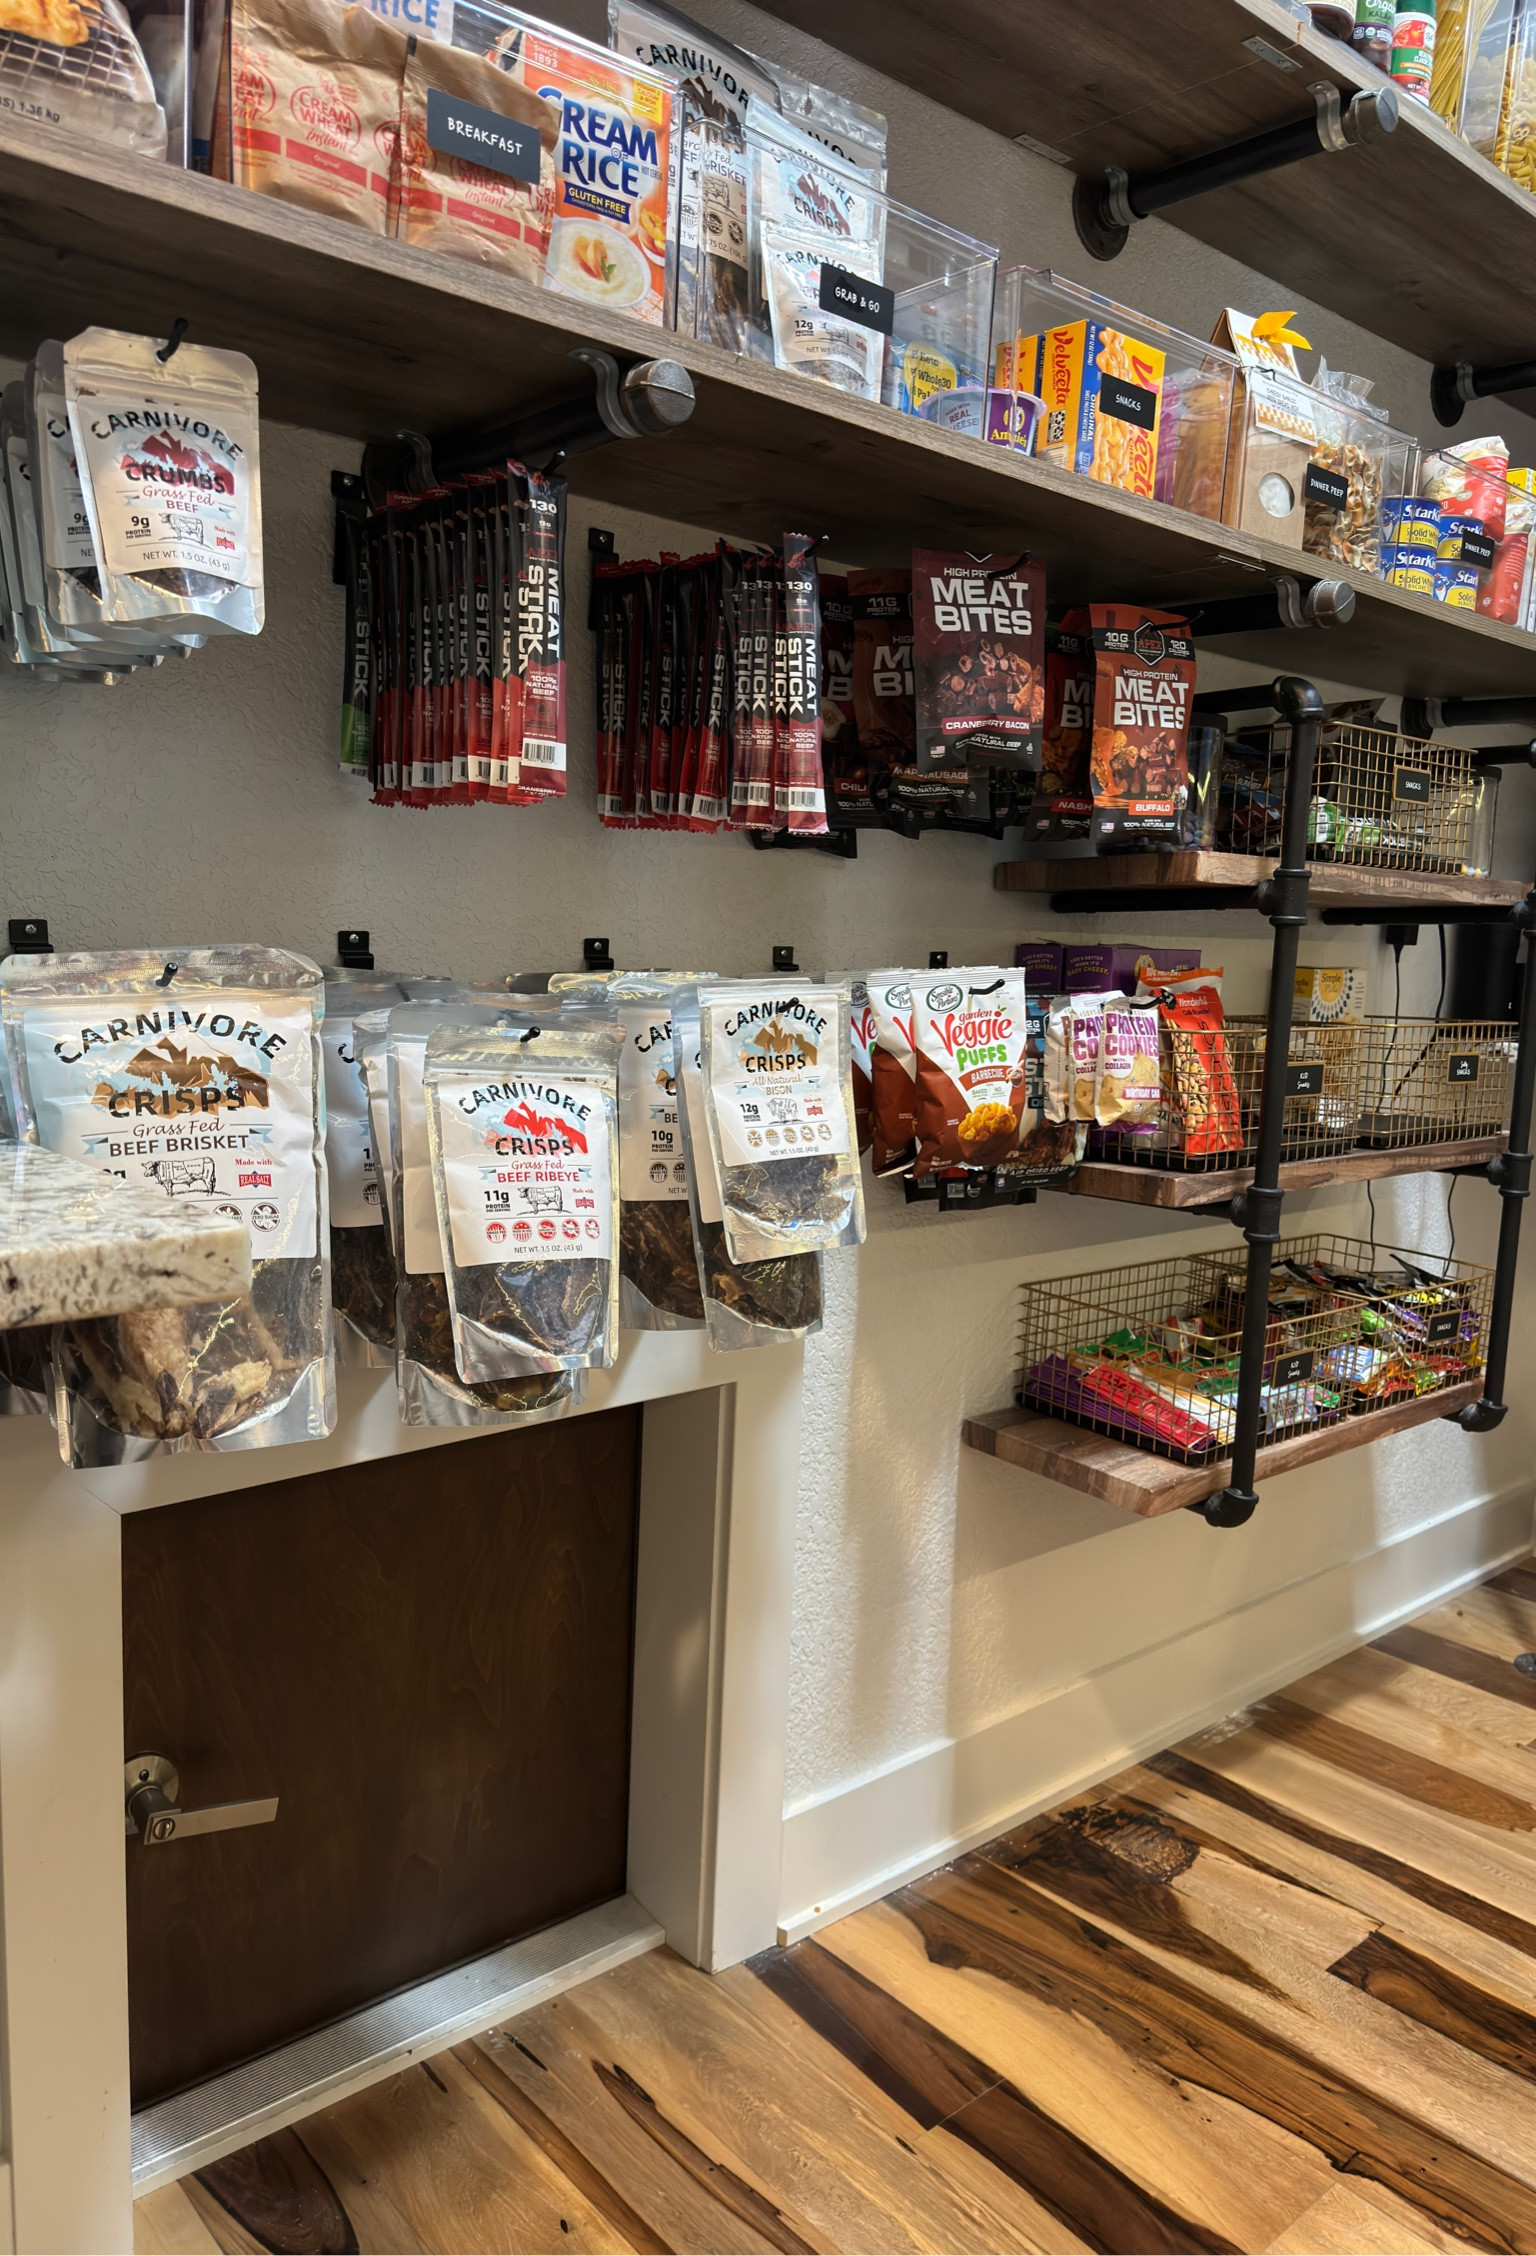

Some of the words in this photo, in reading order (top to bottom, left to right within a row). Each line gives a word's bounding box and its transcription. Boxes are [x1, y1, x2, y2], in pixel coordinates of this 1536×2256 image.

[533, 52, 558, 68] 1893
[299, 90, 353, 126] CREAM
[299, 107, 351, 141] WHEAT
[447, 117, 523, 156] BREAKFAST
[611, 148, 628, 161] OF
[562, 139, 640, 199] RICE
[710, 161, 747, 185] RISKET
[568, 187, 603, 206] GLUTEN
[604, 200, 626, 215] FREE
[794, 196, 843, 236] CRISPS
[834, 286, 857, 305] GRAB
[860, 296, 867, 308] &
[868, 300, 880, 313] GO
[794, 319, 813, 331] 12g
[919, 351, 940, 367] Keto
[1053, 330, 1074, 405] Velveeta
[918, 369, 951, 391] Whole30
[1115, 394, 1142, 412] SNACKS
[949, 409, 971, 424] REAL
[1088, 394, 1096, 442] ORIGINAL
[91, 411, 243, 461] CARNIVORE
[125, 463, 225, 495] CRUMBS
[1310, 478, 1329, 492] DINNER
[1330, 484, 1344, 498] PREP
[143, 485, 185, 499] Grass
[188, 490, 215, 506] Fed
[166, 500, 198, 513] BEEF
[530, 499, 557, 514] 130
[131, 515, 150, 528] 9g
[125, 528, 151, 537] PROTEIN
[143, 551, 160, 560] NET
[181, 551, 192, 560] 1.5
[1464, 542, 1479, 553] DINNER
[1480, 547, 1491, 557] PREP
[943, 567, 969, 577] HIGH
[786, 581, 812, 591] 130
[930, 577, 1029, 608] MEAT
[528, 564, 544, 656] STICK
[547, 568, 561, 658] MEAT
[934, 605, 1032, 635] BITES
[476, 593, 491, 677] STICK
[1104, 641, 1129, 649] PROTEIN
[1105, 632, 1129, 643] 10G
[1170, 640, 1187, 650] 120
[354, 621, 370, 697] STICK
[530, 675, 556, 685] 100%
[736, 637, 751, 712] STICK
[752, 636, 768, 711] STICK
[775, 638, 787, 715] STICK
[788, 637, 804, 715] STICK
[805, 638, 817, 716] MEAT
[1123, 668, 1142, 677] HIGH
[1143, 670, 1178, 681] PROTEIN
[526, 682, 558, 691] NATURAL
[532, 688, 554, 696] BEEF
[660, 656, 673, 727] STICK
[709, 653, 726, 728] STICK
[1115, 676, 1189, 705] MEAT
[946, 719, 1004, 731] CRANBERRY
[1005, 720, 1030, 730] BACON
[1114, 702, 1186, 730] BITES
[840, 782, 867, 792] CHILI
[1135, 804, 1170, 812] BUFFALO
[1321, 974, 1342, 985] Simple
[959, 1009, 993, 1025] garden
[1106, 1012, 1157, 1037] PROTEIN
[54, 1011, 287, 1065] CARNIVORE
[930, 1013, 1013, 1057] Veggie
[1105, 1034, 1159, 1057] COOKIES
[746, 1053, 807, 1074] CRISPS
[956, 1044, 1007, 1072] PUFFS
[971, 1068, 1005, 1083] BARBECUE
[766, 1085, 793, 1096] BISON
[108, 1086, 245, 1118] CRISPS
[458, 1082, 592, 1123] CARNIVORE
[740, 1103, 759, 1115] 12g
[133, 1121, 186, 1138] Grass
[189, 1119, 224, 1134] Fed
[651, 1130, 673, 1144] 10g
[110, 1139, 159, 1157] BEEF
[166, 1135, 249, 1152] BRISKET
[495, 1137, 574, 1157] CRISPS
[511, 1160, 543, 1170] Grass
[544, 1160, 565, 1169] Fed
[497, 1173, 531, 1183] BEEF
[535, 1171, 581, 1182] RIBEYE
[484, 1190, 510, 1203] 11g
[564, 1244, 575, 1252] (43
[576, 1244, 583, 1252] g)
